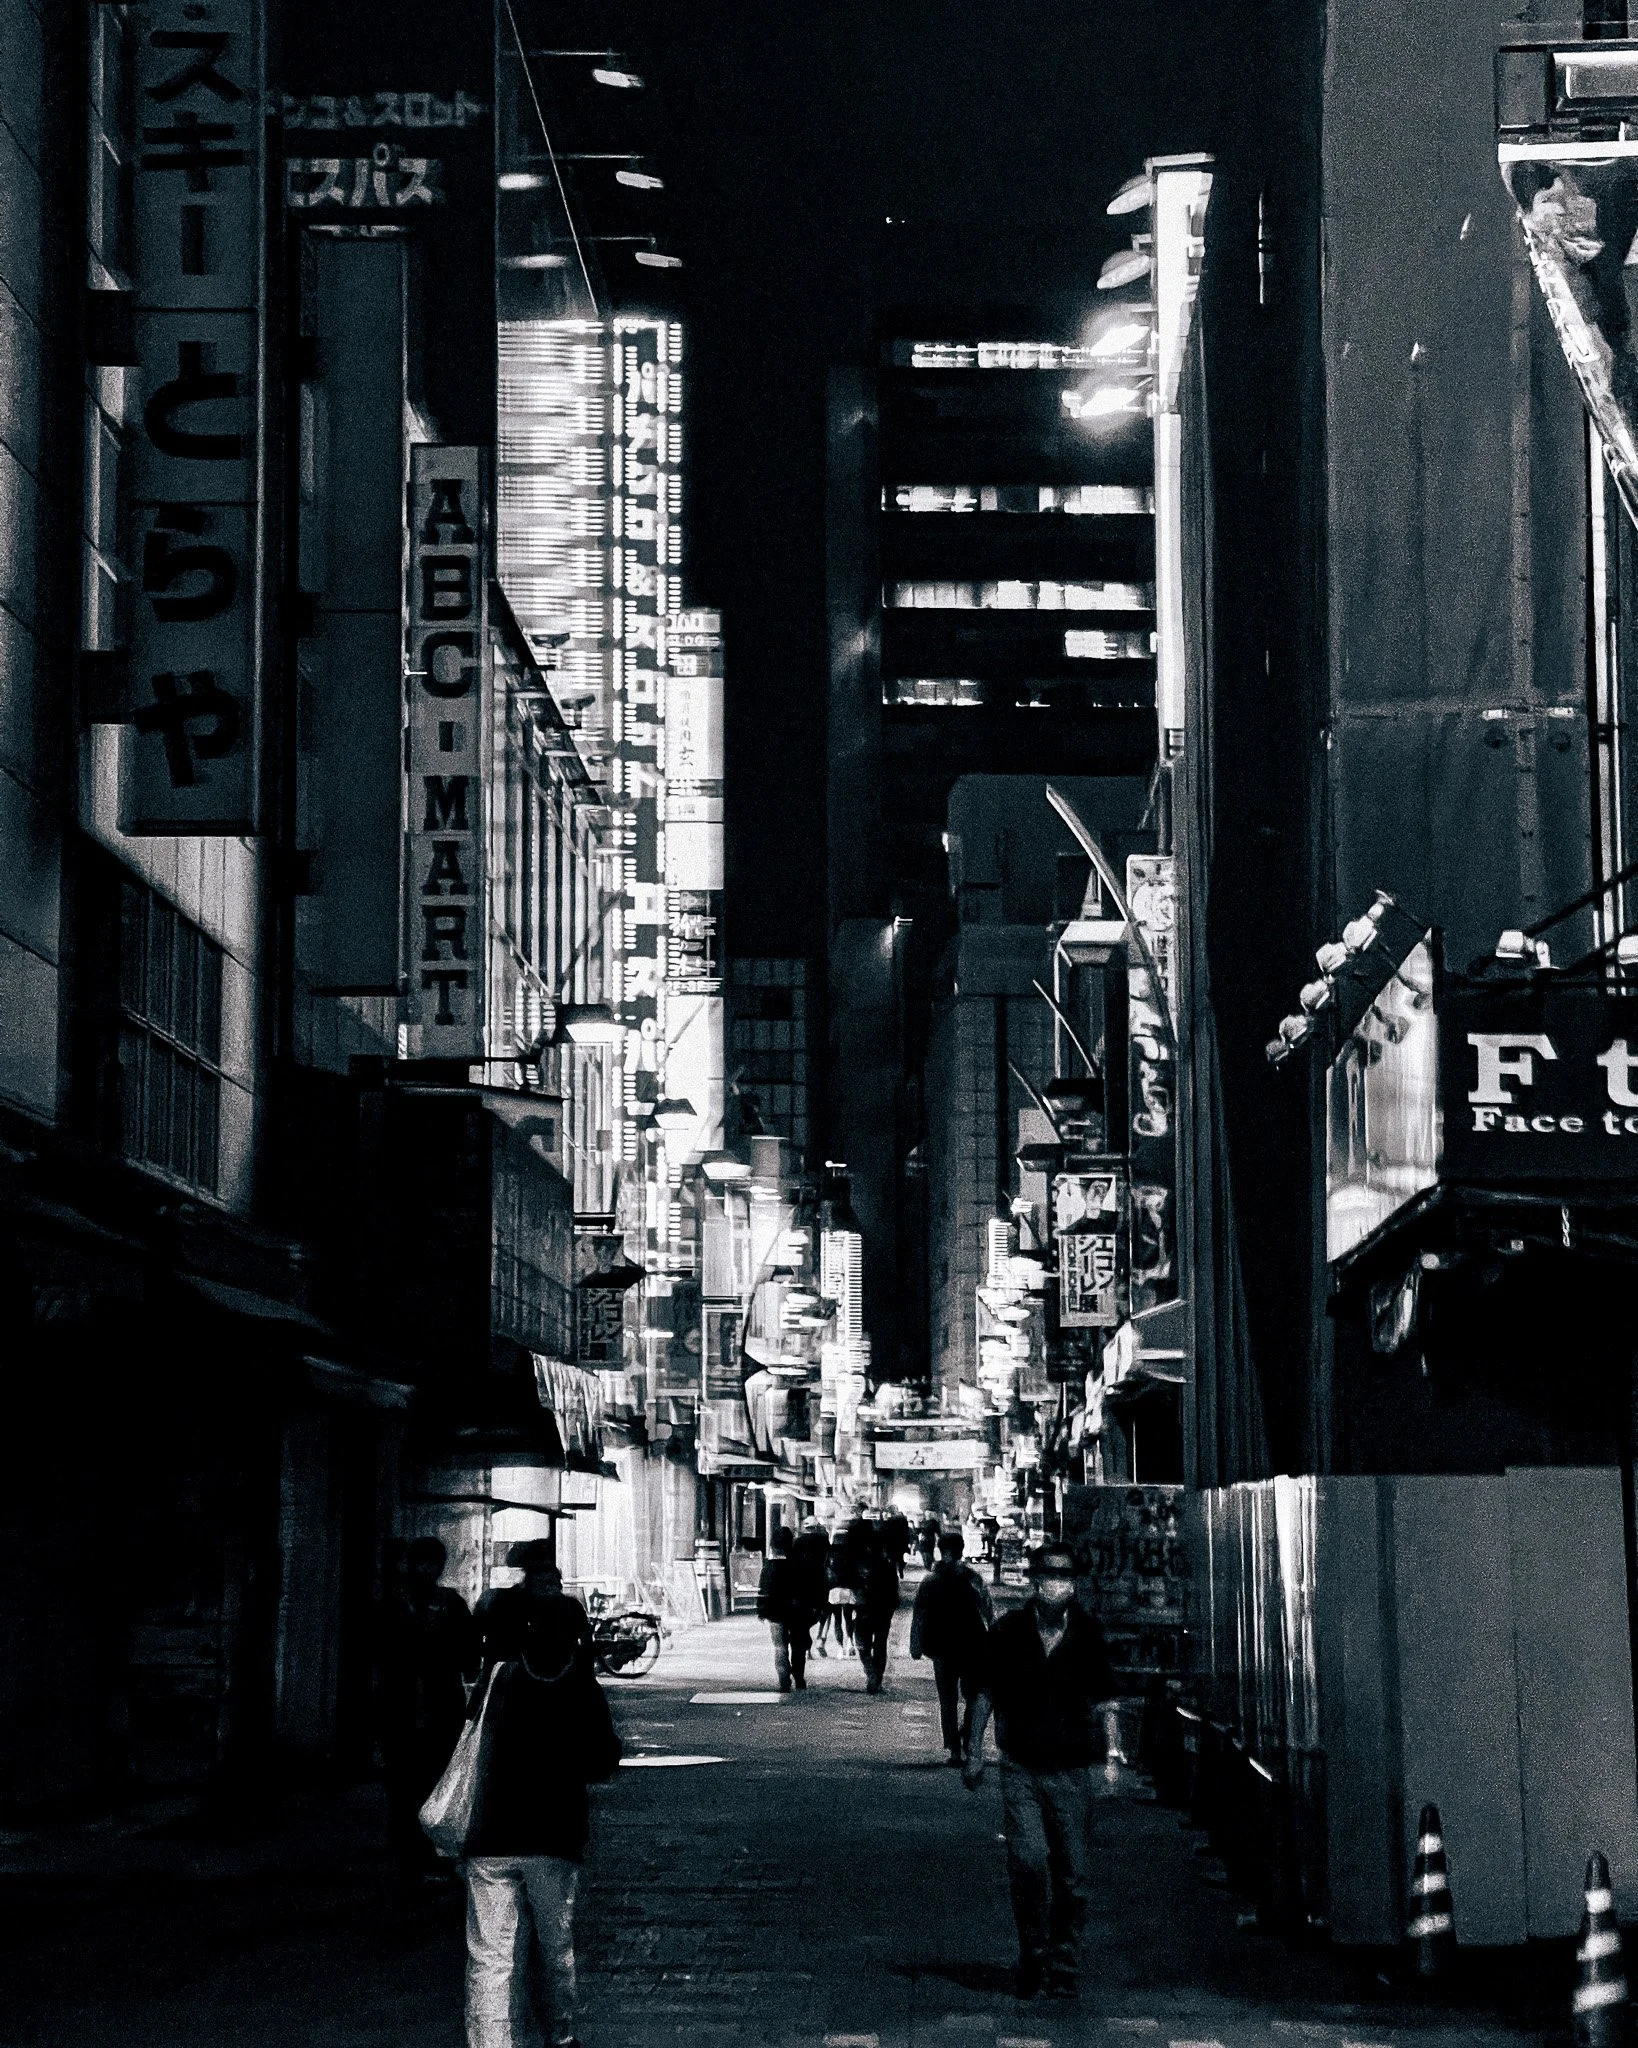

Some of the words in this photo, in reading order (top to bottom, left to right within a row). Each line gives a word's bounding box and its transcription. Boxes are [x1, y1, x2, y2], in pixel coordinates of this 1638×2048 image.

[420, 479, 474, 1027] ABC-MART
[1467, 1033, 1558, 1103] F
[1472, 1107, 1584, 1132] Face
